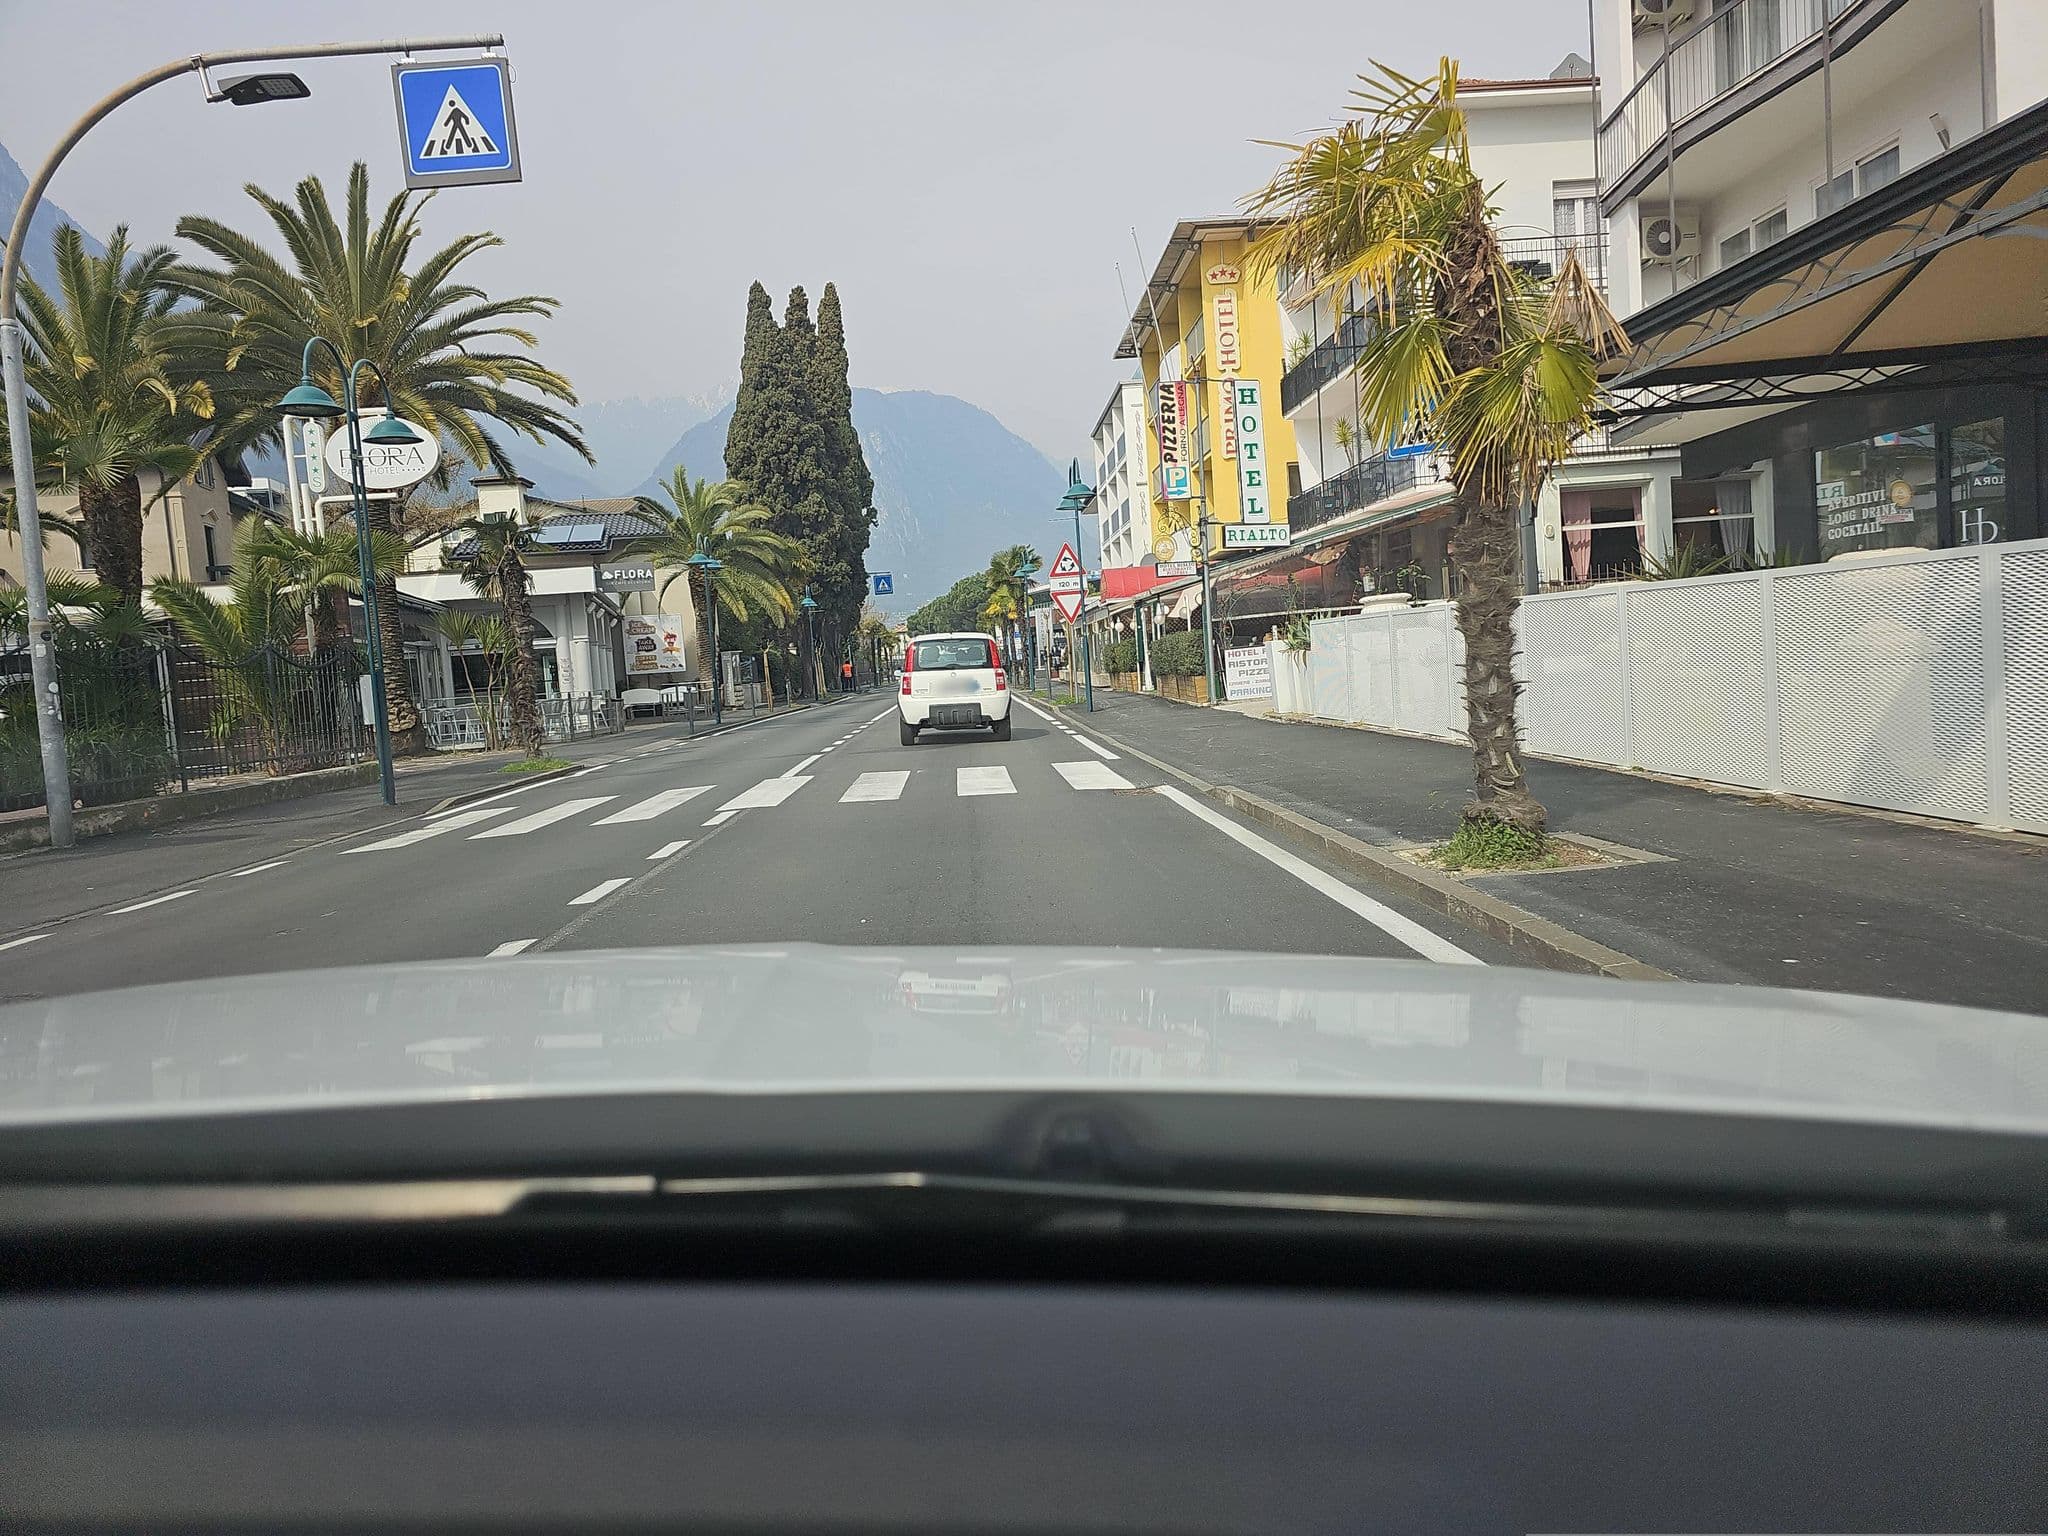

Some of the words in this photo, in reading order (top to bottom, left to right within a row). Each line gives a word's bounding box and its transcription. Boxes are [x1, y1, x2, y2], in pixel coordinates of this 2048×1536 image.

[1217, 294, 1236, 366] HOTEL
[1159, 383, 1178, 464] PIZZERIA
[339, 446, 426, 468] FORA
[1180, 429, 1188, 463] FORNO
[1237, 387, 1263, 515] HOTEL
[1827, 489, 1886, 511] APERITIVI
[1827, 511, 1857, 526] LONG
[1861, 503, 1898, 519] DRINK
[1226, 528, 1288, 542] RIALTO
[1827, 521, 1884, 540] COCKTAIL
[614, 569, 653, 580] FLORA
[1227, 648, 1259, 658] HOTEL
[1230, 686, 1272, 697] PARKING
